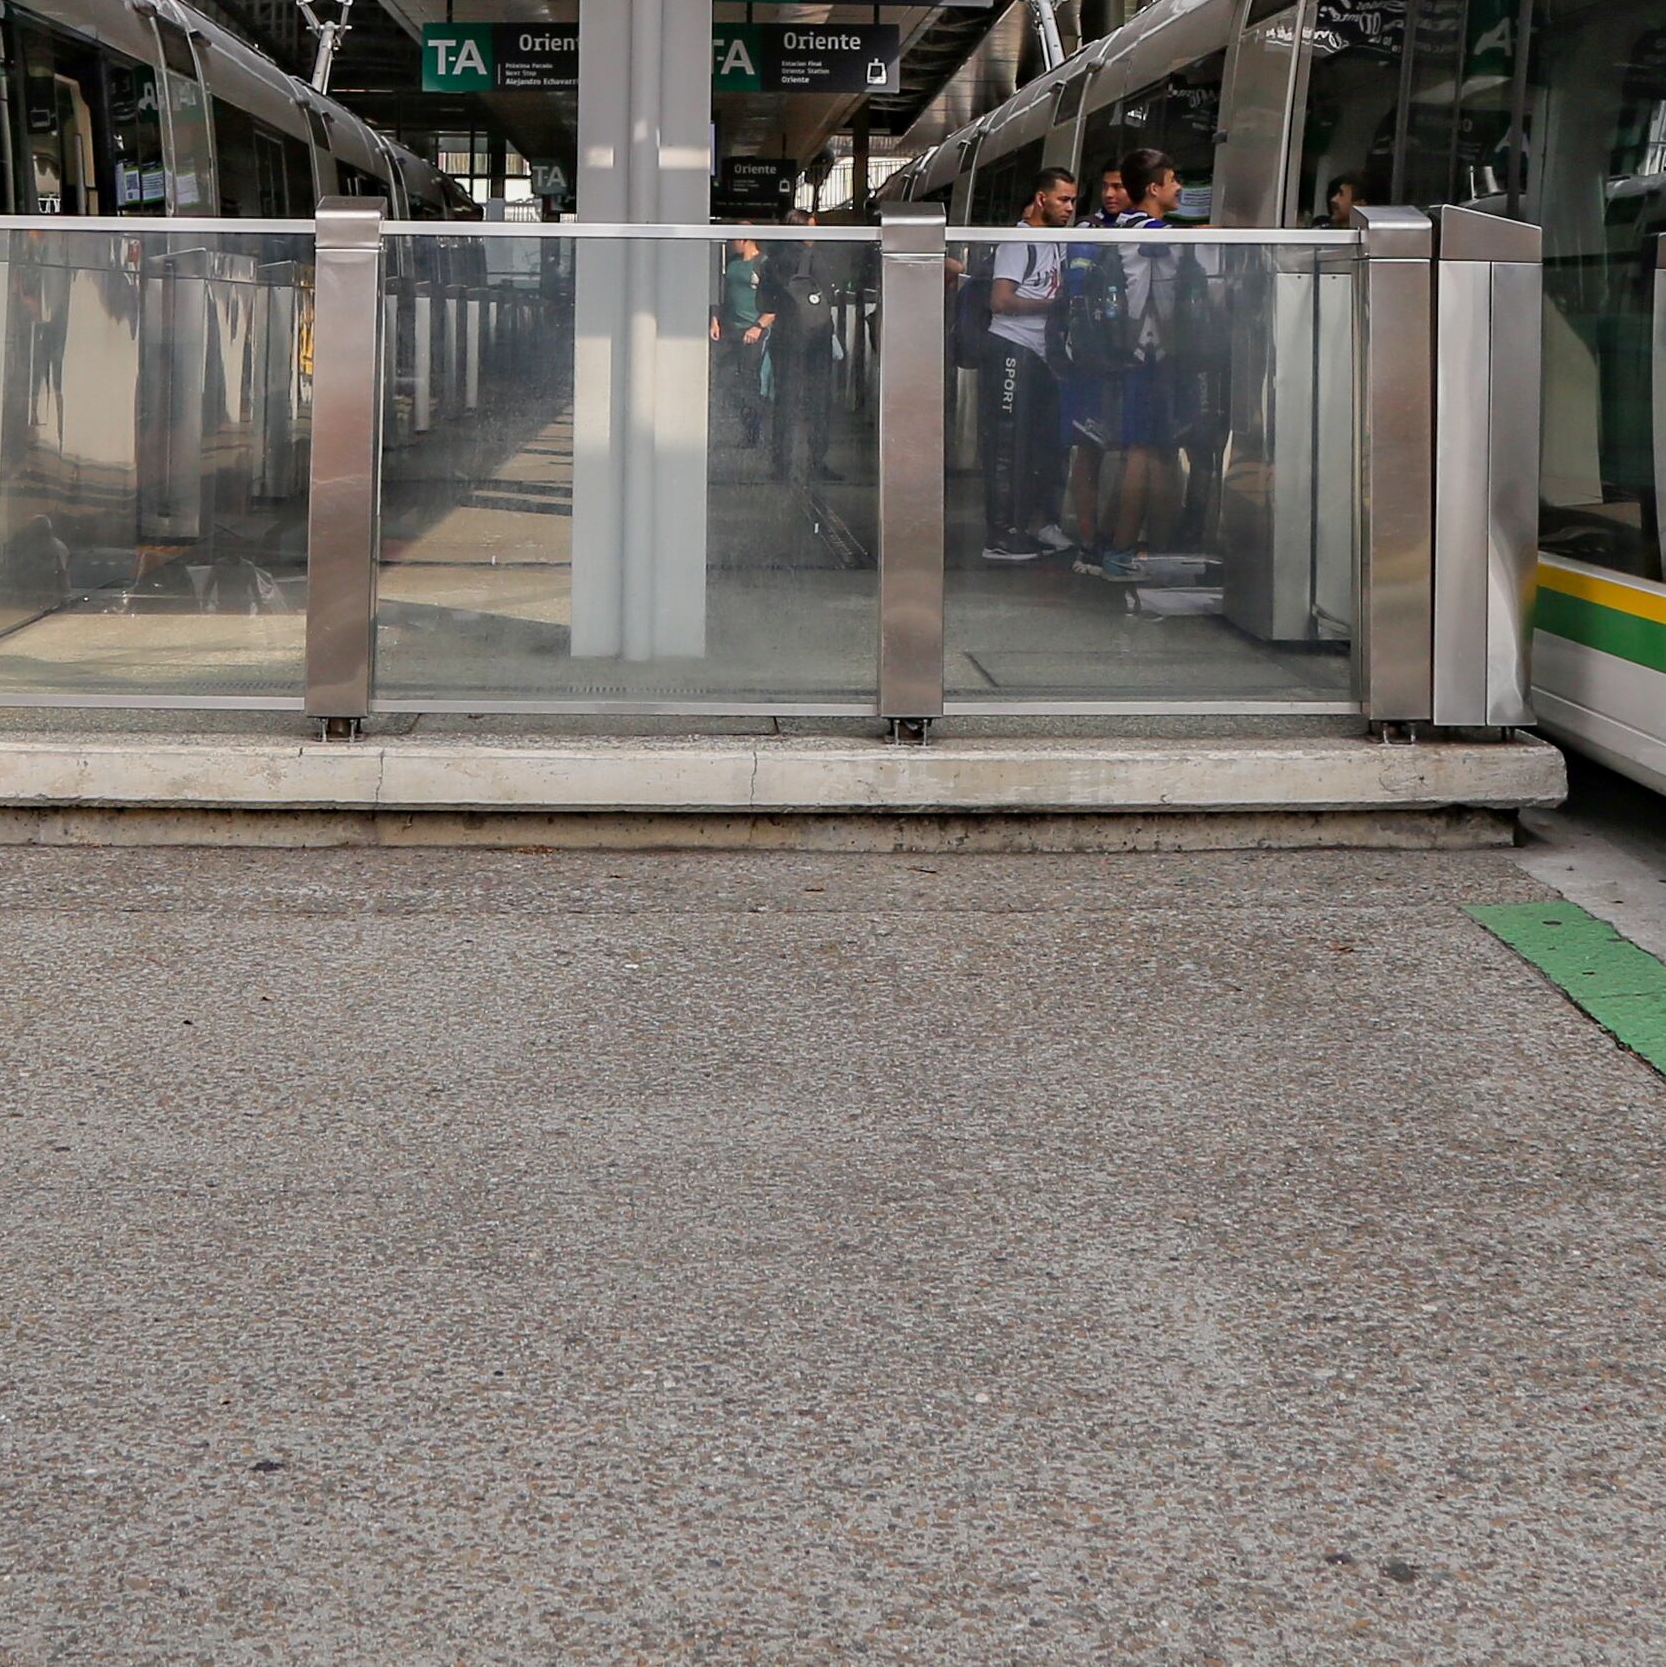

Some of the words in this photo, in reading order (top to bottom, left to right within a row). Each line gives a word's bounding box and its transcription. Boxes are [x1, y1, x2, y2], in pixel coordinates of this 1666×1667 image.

[519, 33, 580, 51] Orien
[783, 32, 861, 50] Oriente
[505, 77, 541, 86] Alejandro
[543, 77, 579, 85] Echavarr
[734, 163, 777, 175] Oriente
[1002, 357, 1016, 414] SPORT
